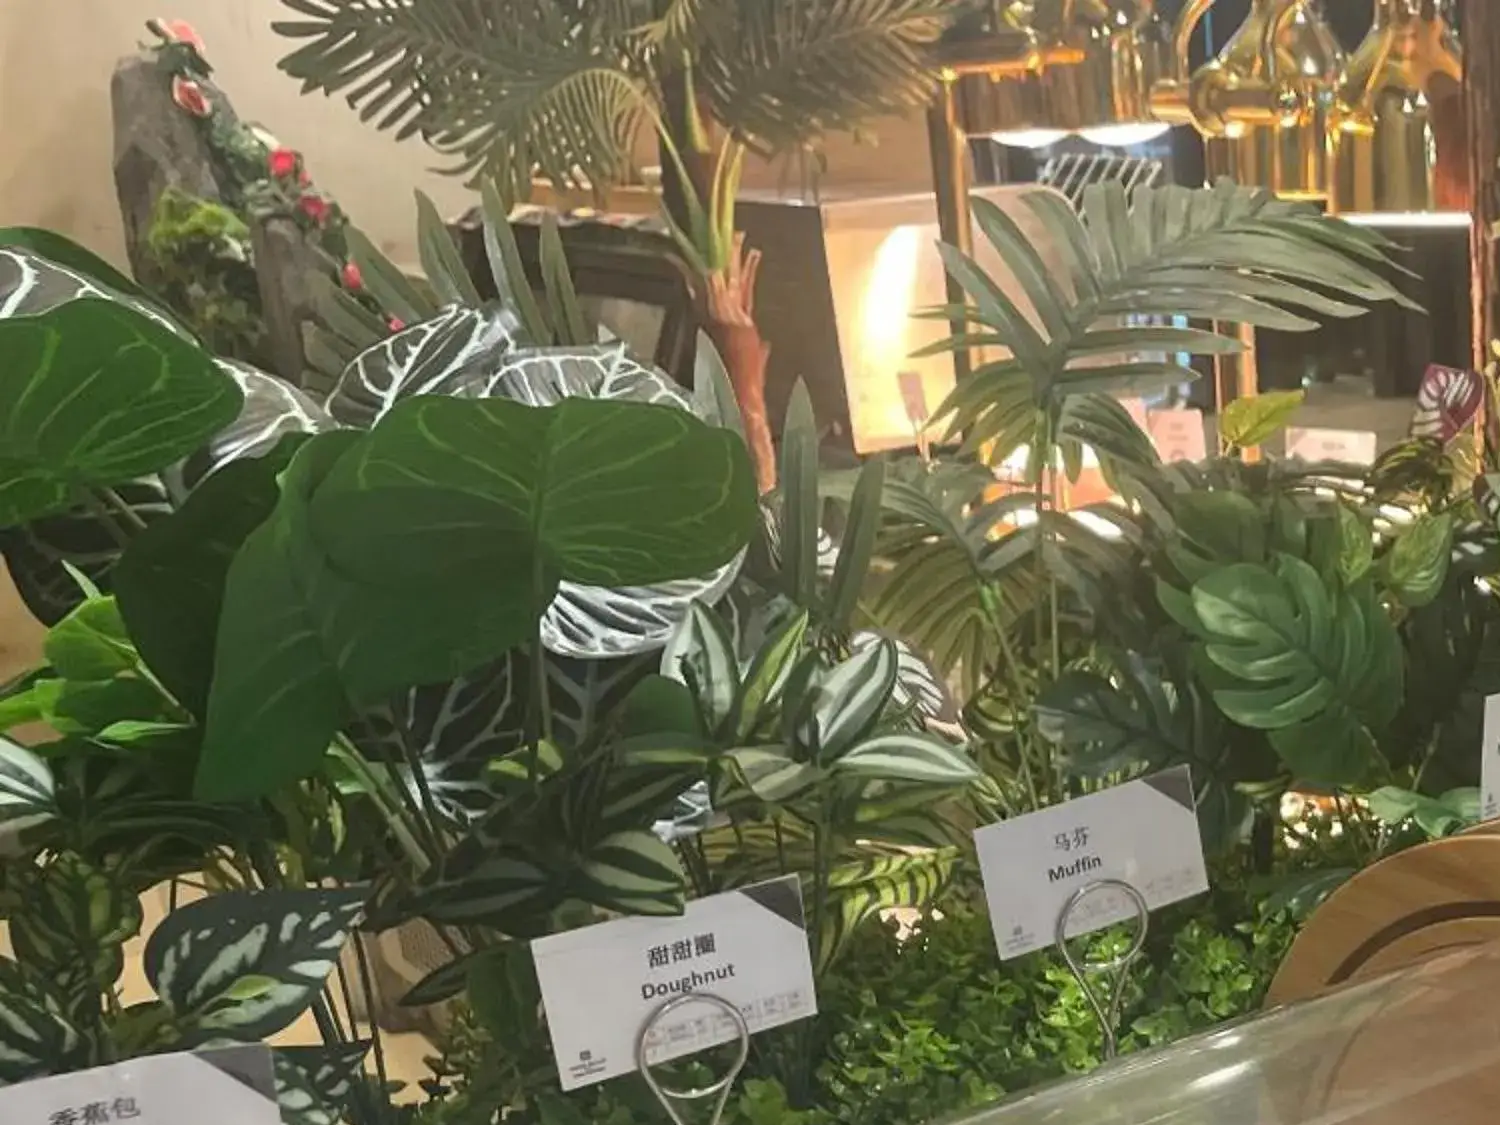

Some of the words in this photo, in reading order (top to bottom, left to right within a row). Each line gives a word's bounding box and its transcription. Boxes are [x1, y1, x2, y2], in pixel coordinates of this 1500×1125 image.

[1054, 826, 1090, 852] 马芬
[1047, 854, 1102, 884] Muffin
[646, 932, 717, 969] 甜甜圈
[640, 963, 736, 1001] Doughnut
